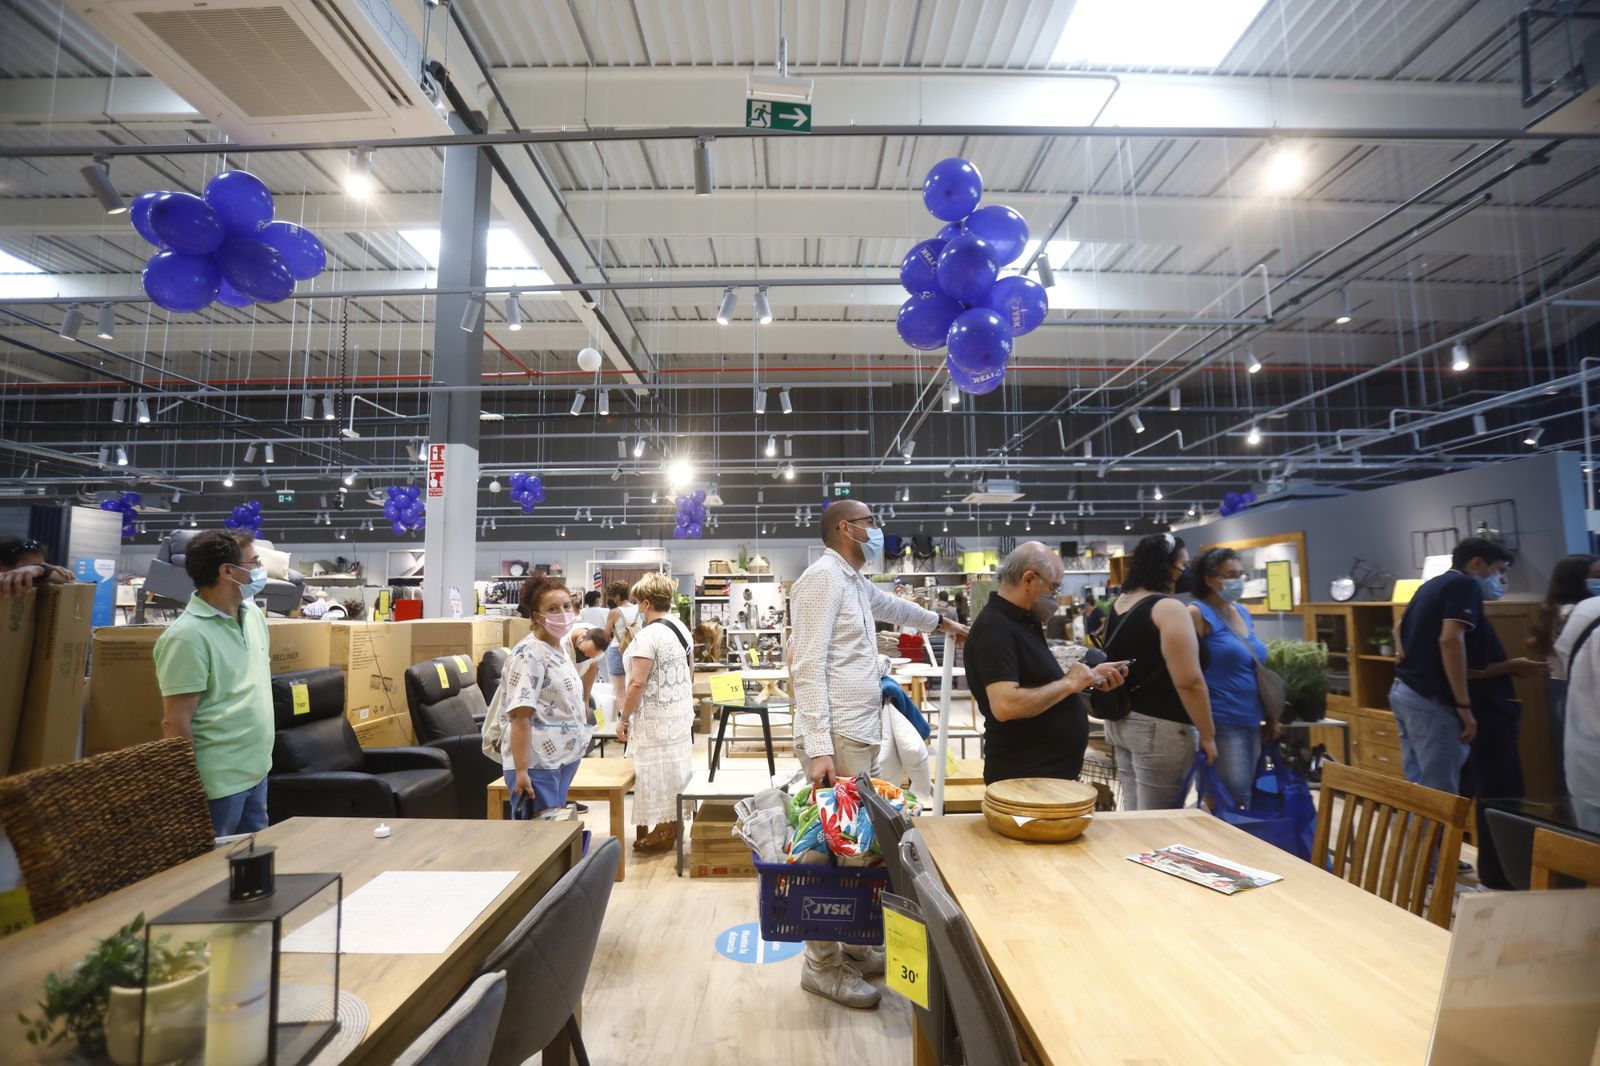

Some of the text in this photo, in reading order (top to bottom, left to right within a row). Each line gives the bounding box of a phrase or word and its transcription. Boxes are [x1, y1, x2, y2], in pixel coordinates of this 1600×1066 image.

[920, 247, 937, 266] JYSK
[272, 651, 299, 662] RECLINER
[813, 903, 852, 915] JYSK
